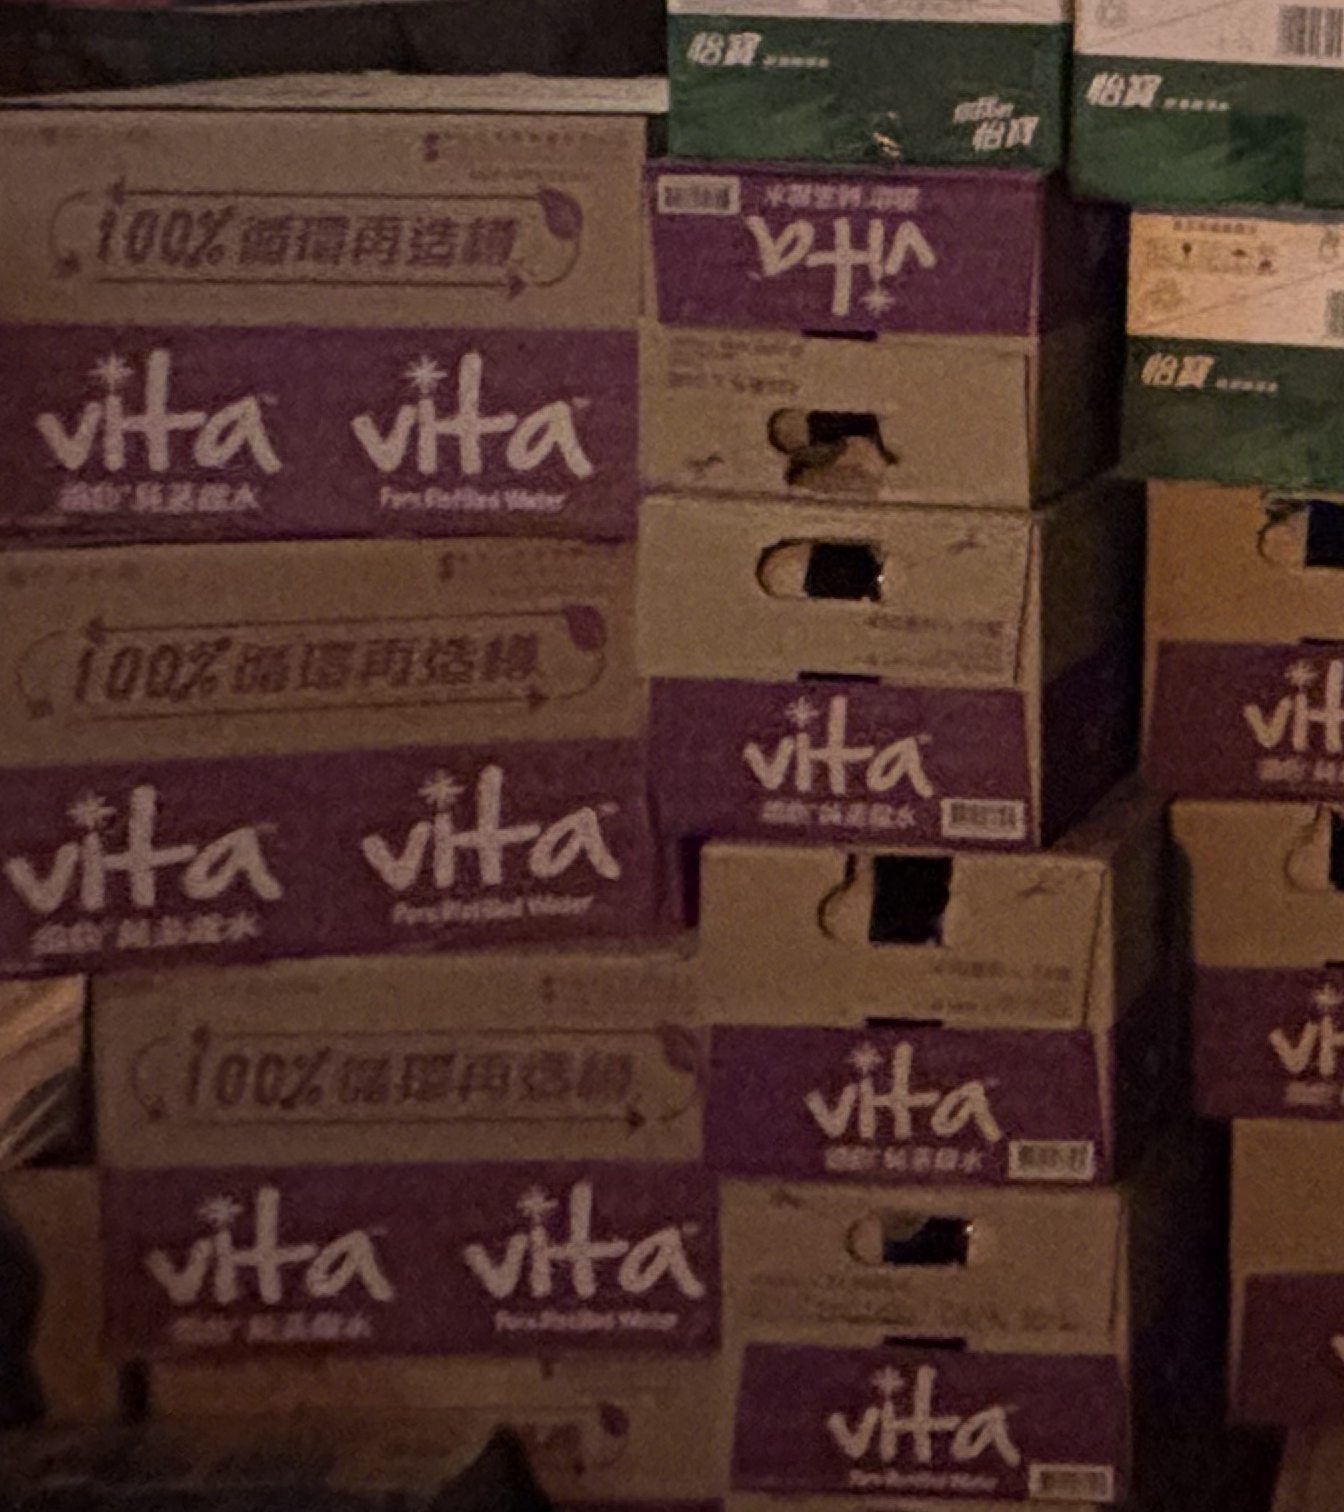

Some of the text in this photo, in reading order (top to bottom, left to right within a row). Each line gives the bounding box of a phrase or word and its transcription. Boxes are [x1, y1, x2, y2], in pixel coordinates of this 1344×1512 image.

[745, 216, 937, 318] vita
[36, 346, 283, 475] vita
[351, 351, 593, 478] vita
[742, 695, 934, 798] vita
[3, 784, 284, 914] vita
[361, 765, 622, 892] vita
[804, 1042, 1001, 1143] vita
[143, 1185, 397, 1305] vita
[462, 1181, 706, 1300] vita
[828, 1365, 1021, 1467] vita
